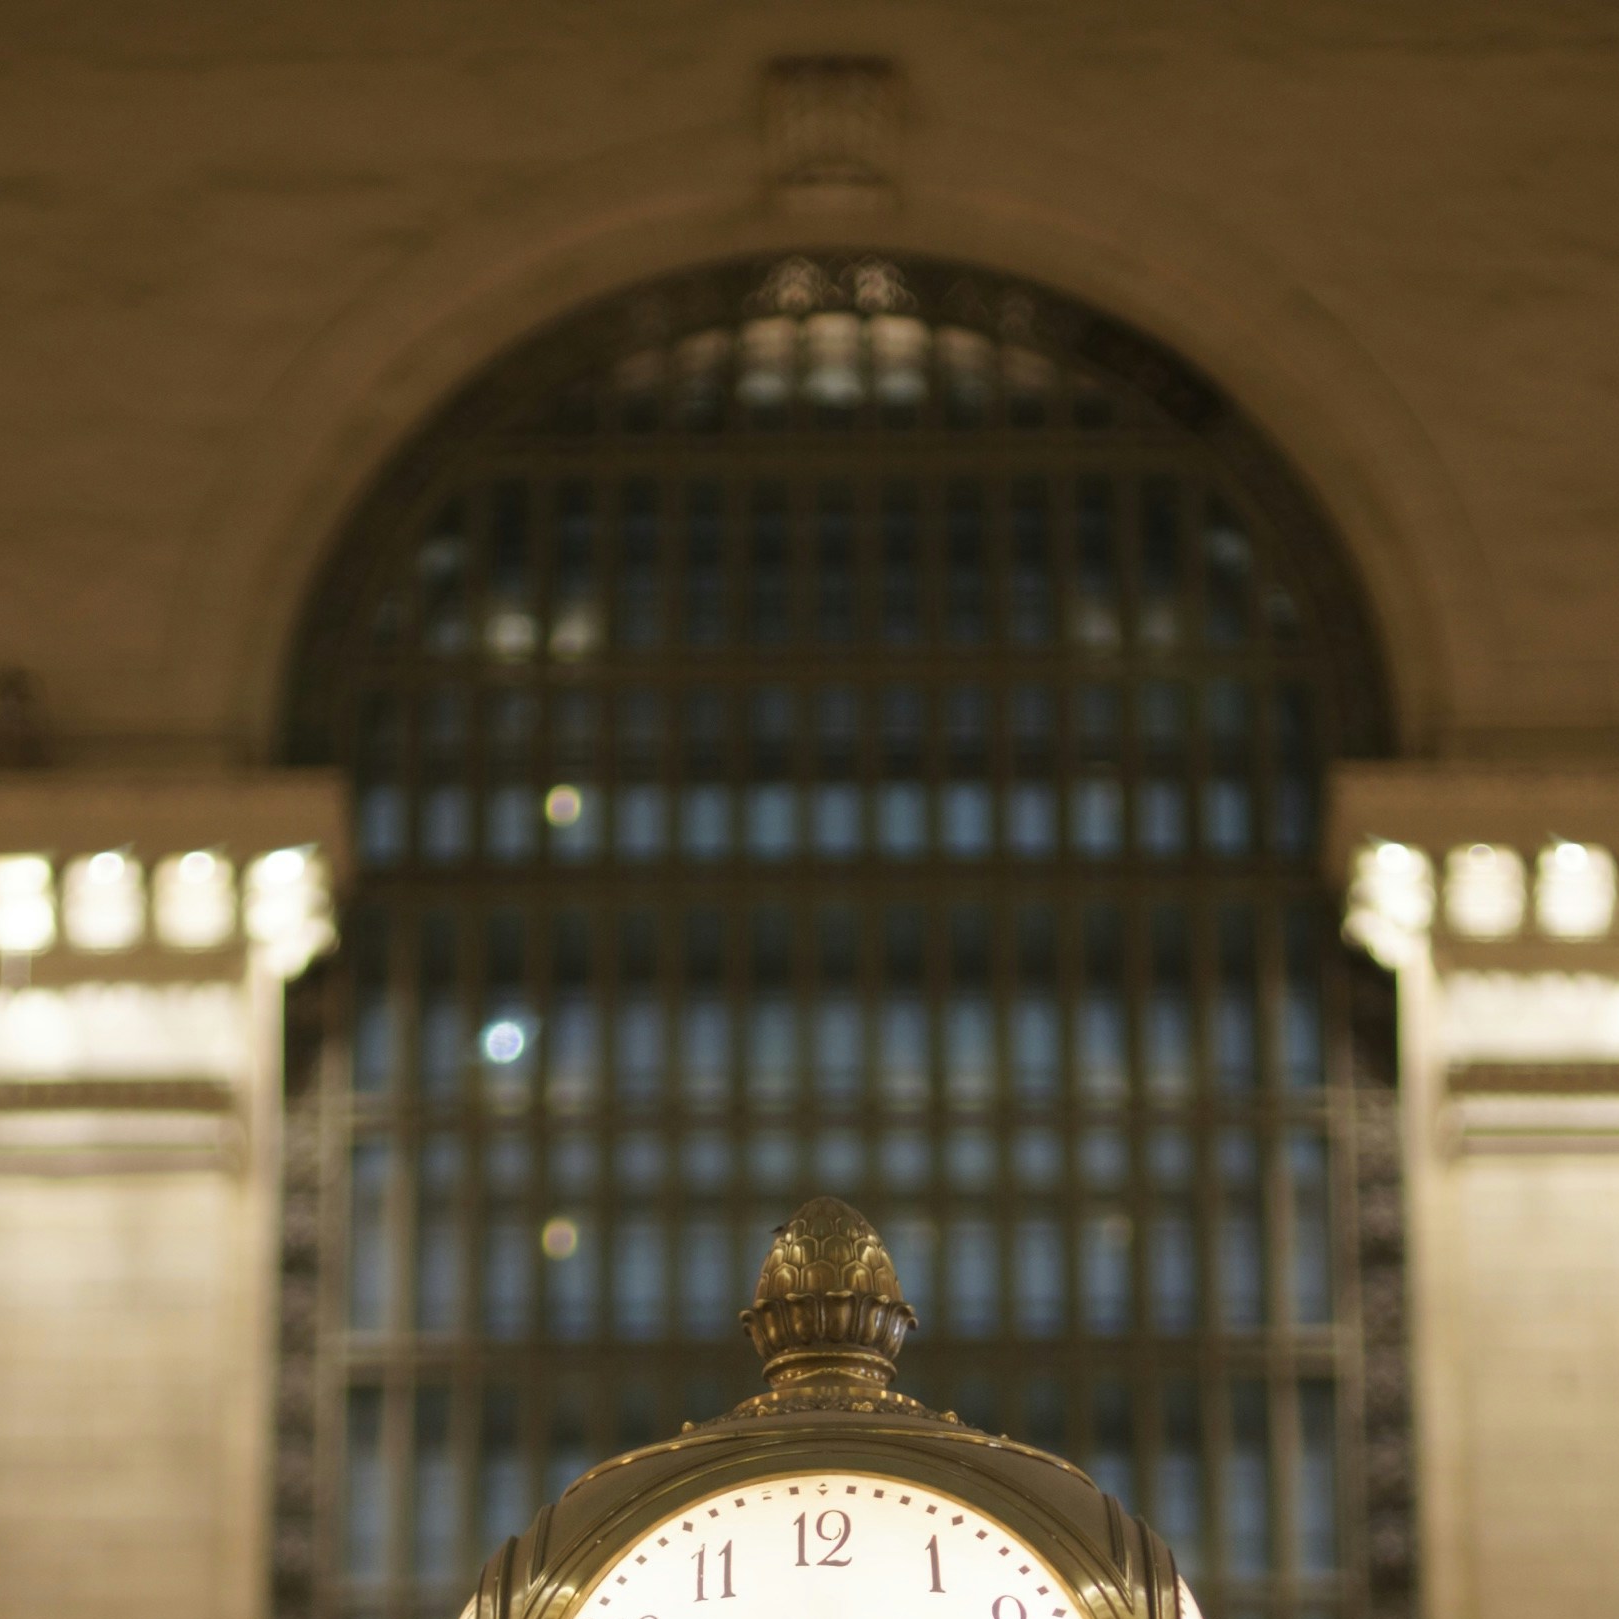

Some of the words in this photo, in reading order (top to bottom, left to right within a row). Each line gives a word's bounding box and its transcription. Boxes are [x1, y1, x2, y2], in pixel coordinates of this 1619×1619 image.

[792, 1509, 852, 1568] 12
[922, 1534, 946, 1593] 1
[691, 1539, 738, 1602] 11
